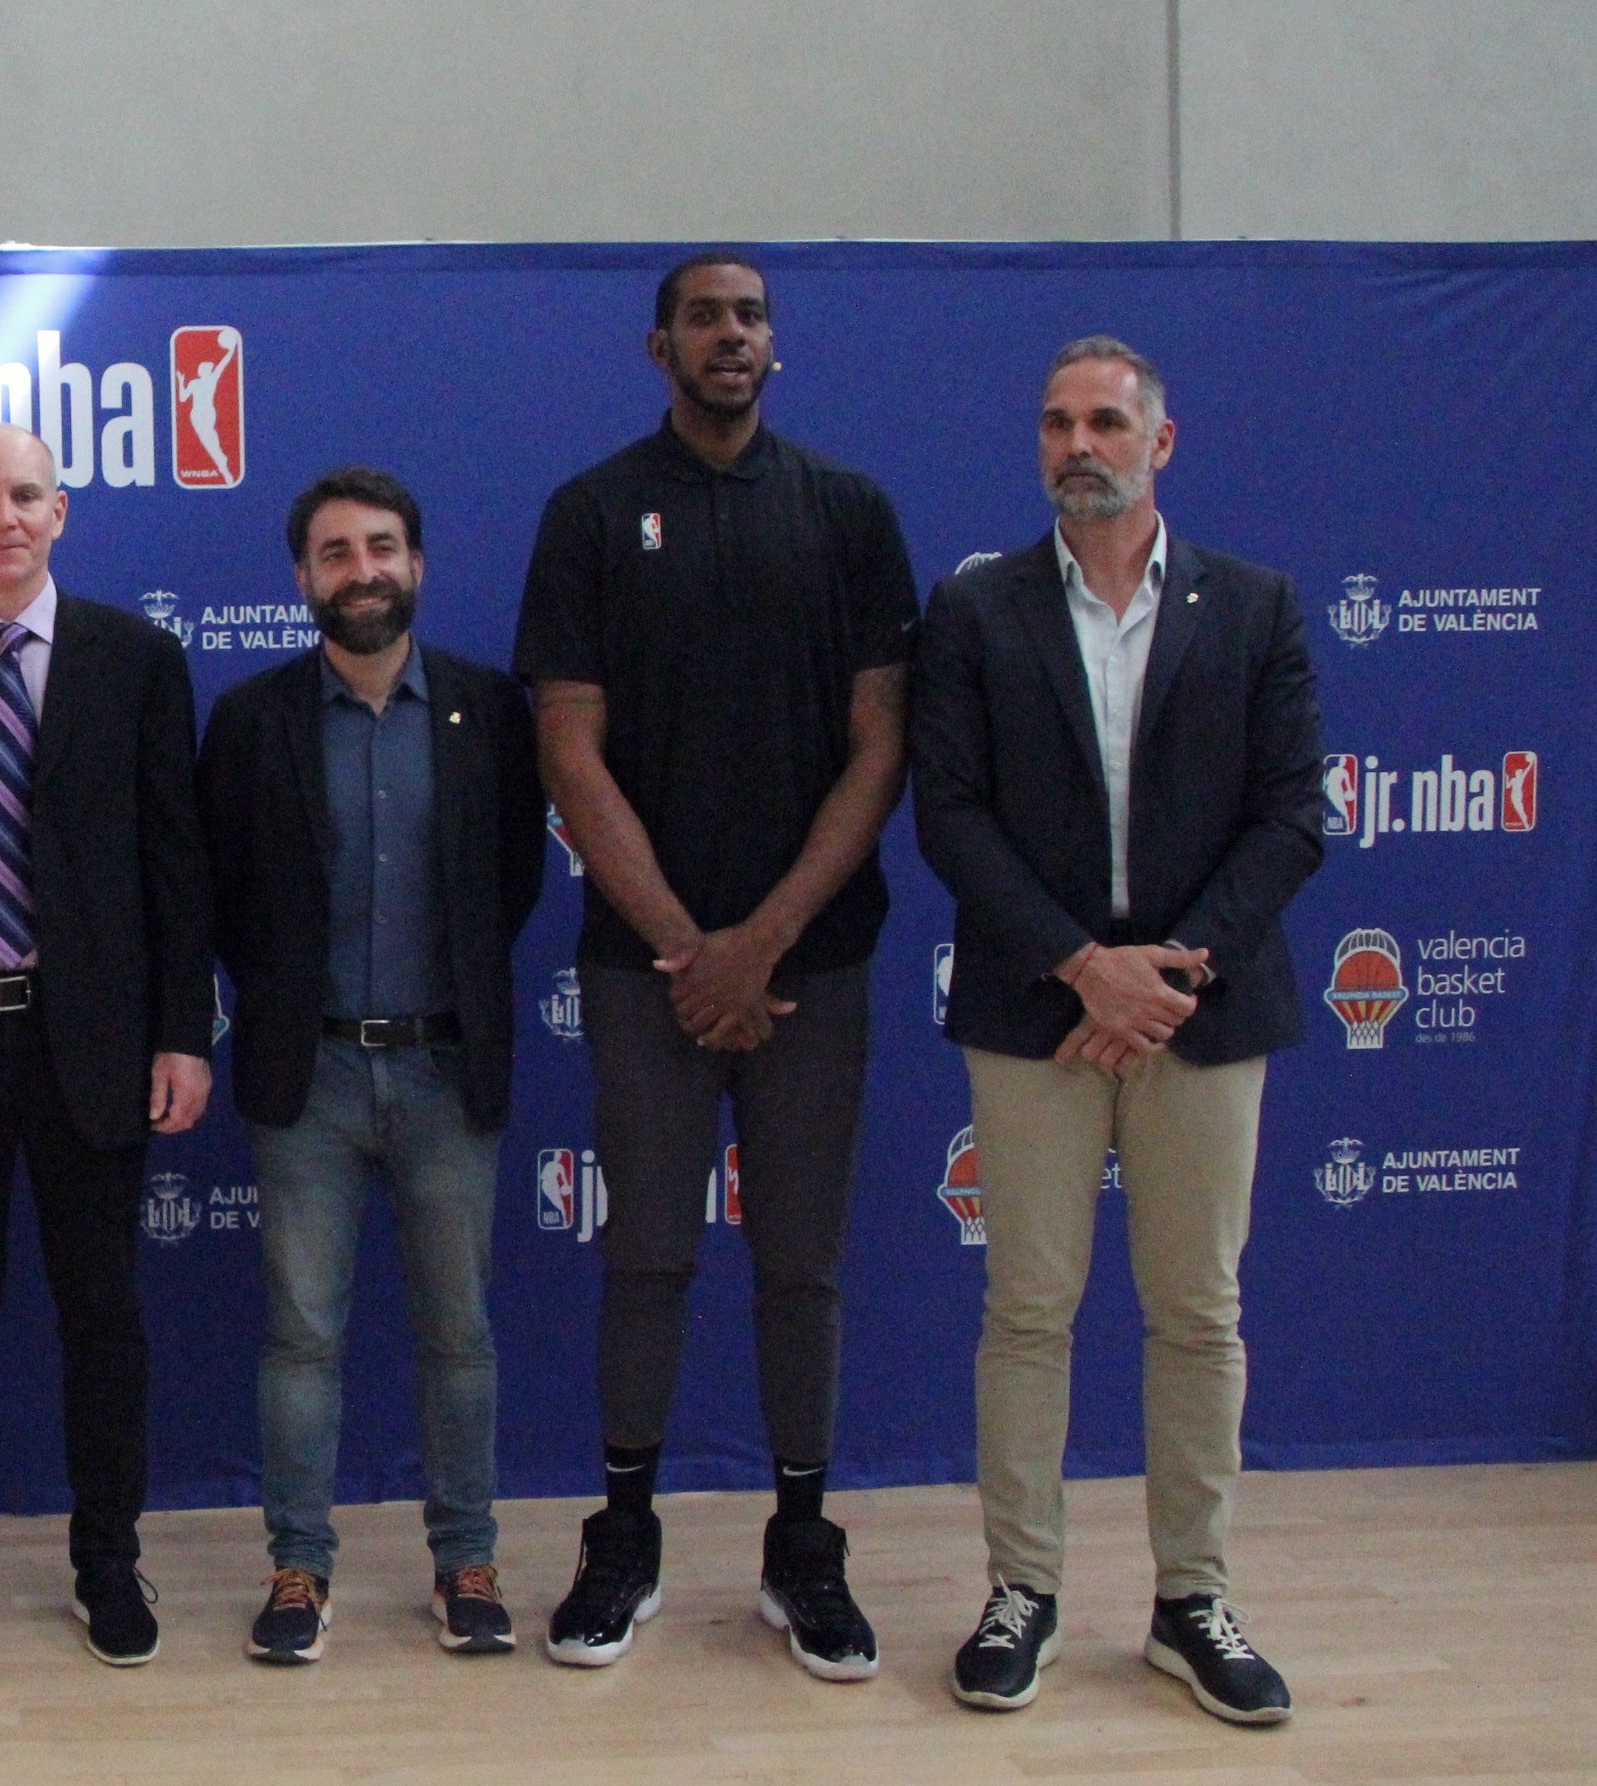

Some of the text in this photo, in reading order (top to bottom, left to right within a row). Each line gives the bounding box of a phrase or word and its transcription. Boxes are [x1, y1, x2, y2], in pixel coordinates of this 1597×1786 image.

[181, 469, 219, 478] WNBA
[1398, 588, 1541, 607] AJUNTAMENT
[1398, 609, 1539, 632] DE VALÈNCIA
[202, 631, 232, 650] DE
[1359, 754, 1495, 848] jr.nba
[1417, 928, 1526, 960] valencia
[1417, 964, 1505, 995] basket
[1415, 999, 1476, 1028] club
[1381, 1148, 1521, 1169] AJUNTAMENT
[1382, 1170, 1518, 1193] DE VALÈNCIA
[210, 1211, 240, 1229] DE
